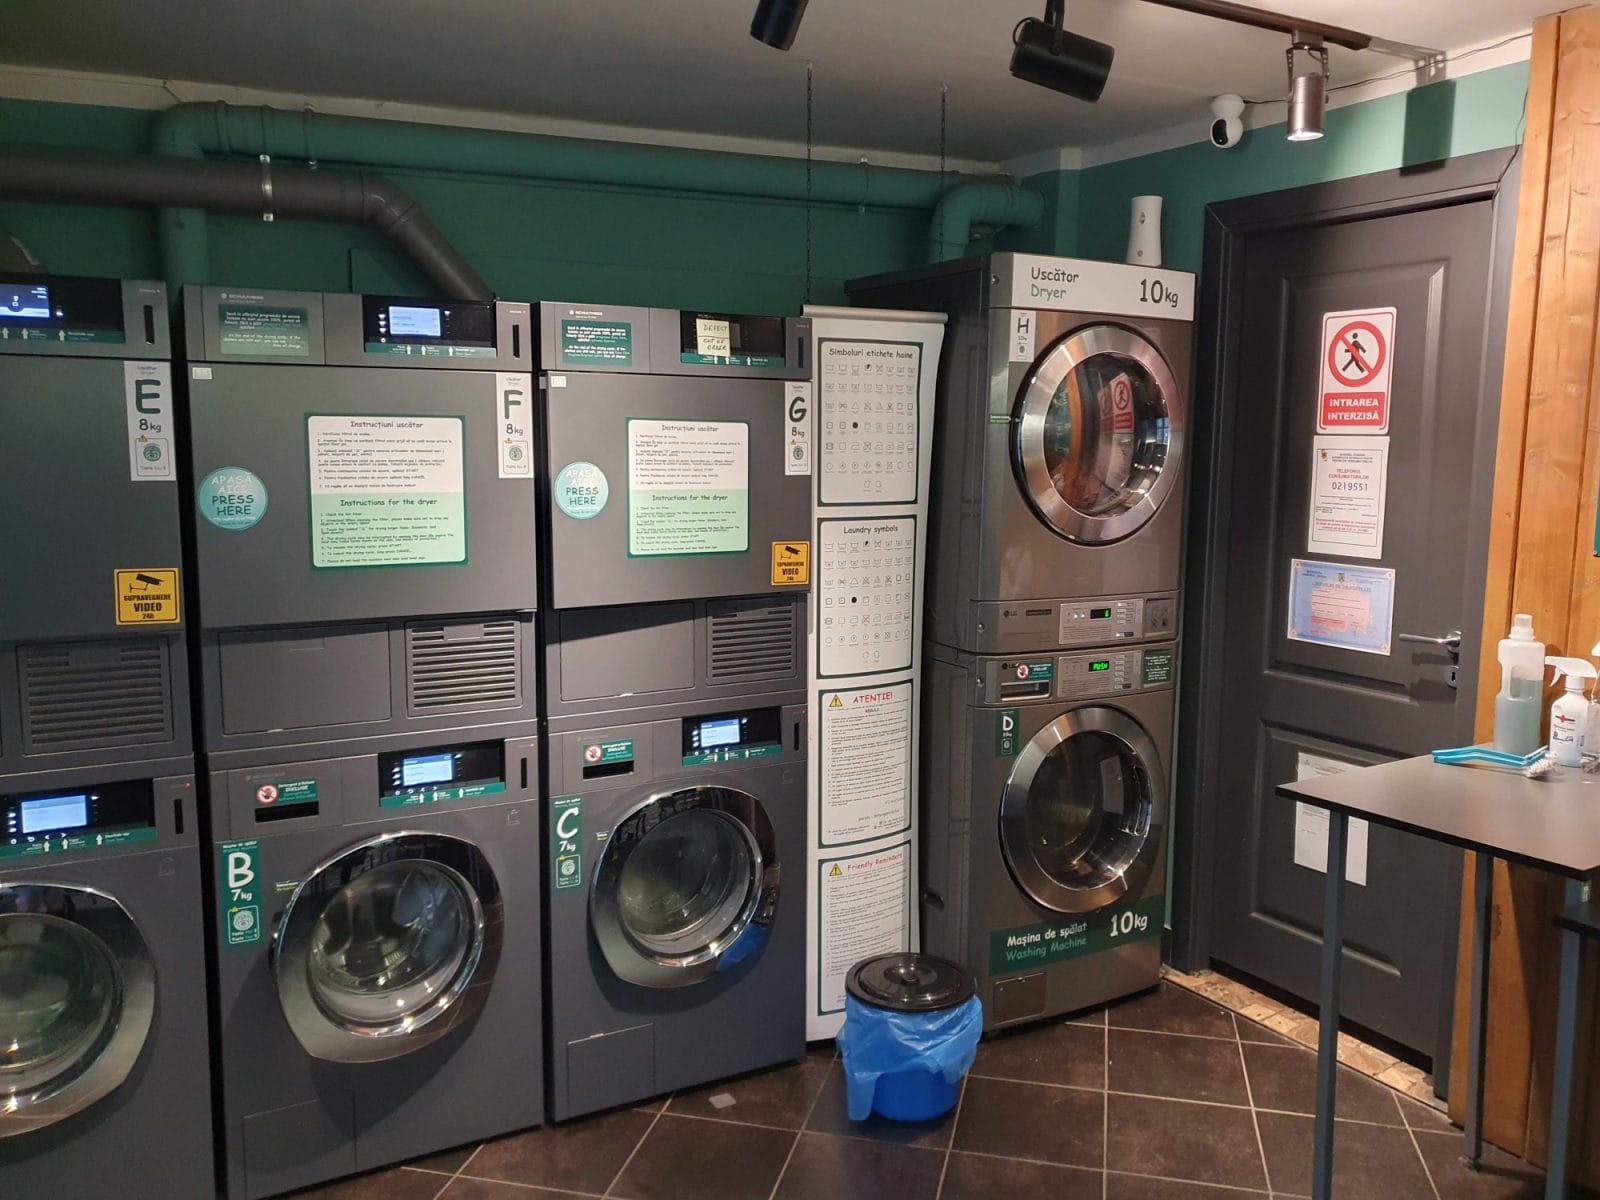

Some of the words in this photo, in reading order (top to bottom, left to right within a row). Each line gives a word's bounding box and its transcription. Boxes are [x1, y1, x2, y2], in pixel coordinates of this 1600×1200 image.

[1031, 266, 1079, 283] Uscător
[1031, 283, 1067, 302] Dryer
[1139, 278, 1179, 308] 10kg
[703, 323, 728, 332] DEFECT
[1017, 317, 1030, 334] H
[829, 347, 864, 357] Simboluri
[866, 349, 894, 358] etichete
[896, 350, 913, 359] haine
[135, 379, 161, 414] E
[503, 389, 523, 420] F
[1329, 398, 1379, 407] INTRAREA
[789, 396, 807, 423] G
[350, 420, 394, 430] Instrucțiuni
[396, 421, 424, 429] uscător
[566, 486, 599, 496] PRESS
[1331, 481, 1368, 491] 0219551
[211, 494, 255, 505] PRESS
[340, 499, 385, 507] Instructions
[388, 499, 400, 507] for
[417, 498, 438, 507] dryer
[569, 496, 597, 506] HERE
[712, 494, 729, 502] dryer
[217, 505, 252, 516] HERE
[843, 525, 871, 535] Laundry
[873, 524, 899, 535] symbols
[782, 567, 800, 576] VIDEO
[133, 602, 163, 612] VIDEO
[1002, 715, 1014, 731] D
[556, 806, 580, 839] C
[228, 851, 255, 889] B
[847, 860, 874, 871] Friendly
[1110, 911, 1148, 937] 10kg
[1044, 929, 1057, 940] de
[1059, 922, 1088, 939] spălat
[1006, 946, 1047, 961] Washing
[1050, 938, 1088, 953] Machine
